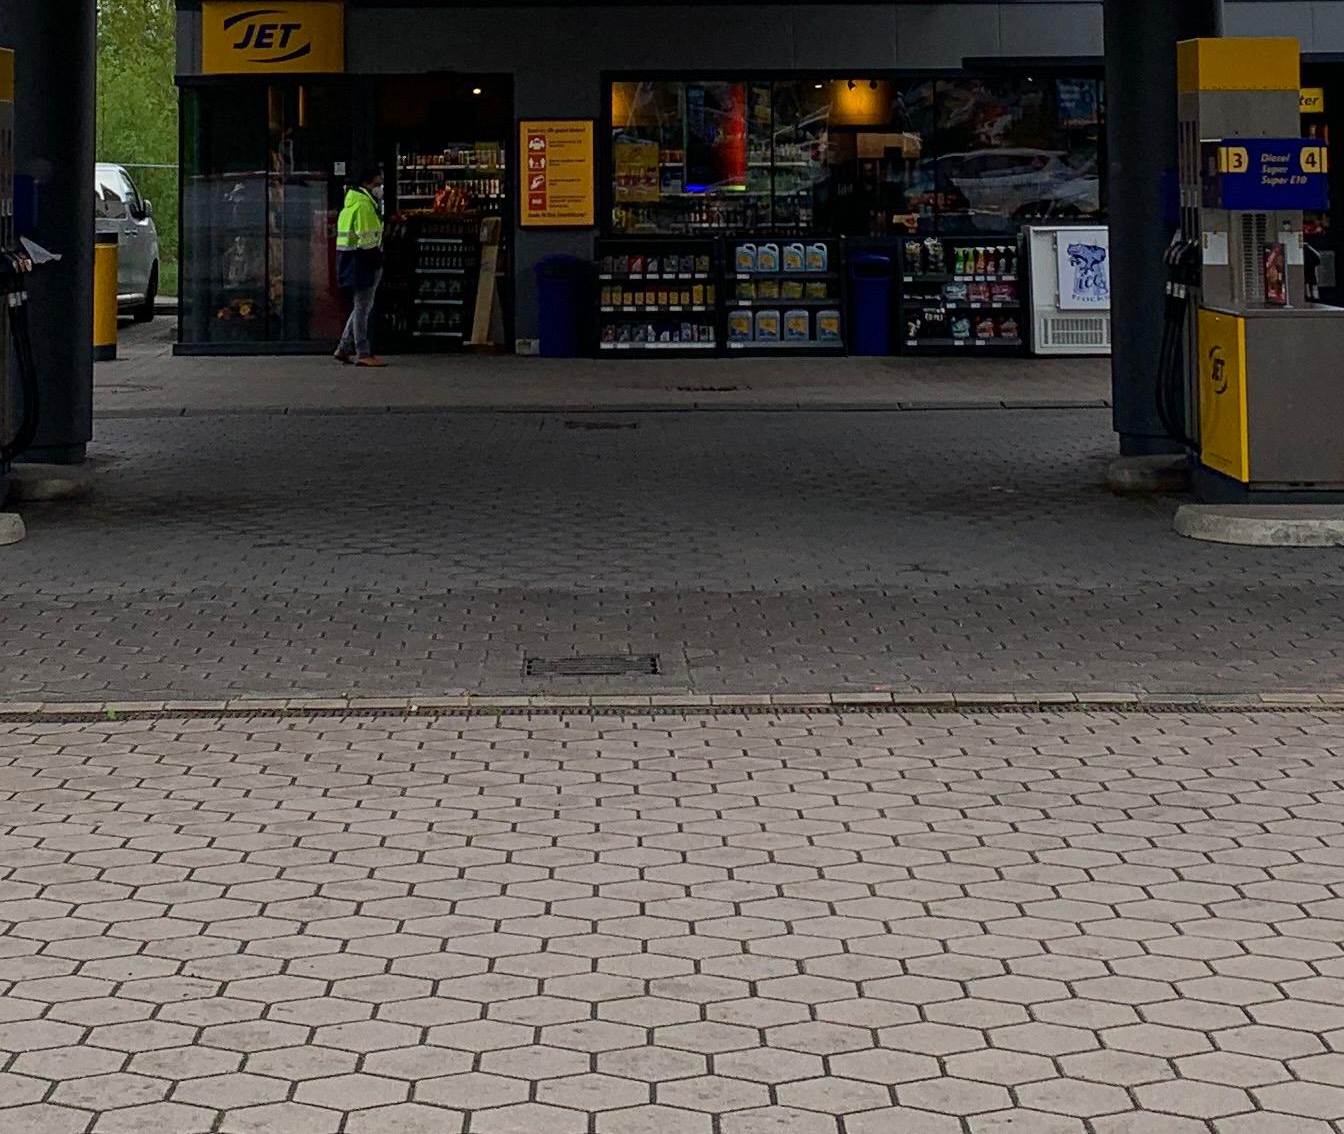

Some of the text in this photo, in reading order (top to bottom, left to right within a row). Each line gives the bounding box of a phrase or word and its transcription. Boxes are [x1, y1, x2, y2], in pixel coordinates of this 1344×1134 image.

[233, 23, 302, 49] JET
[1233, 153, 1243, 168] 3
[1260, 153, 1291, 163] Diesel
[1305, 152, 1317, 168] 4
[1261, 164, 1289, 176] Super
[1260, 175, 1308, 186] Super E10
